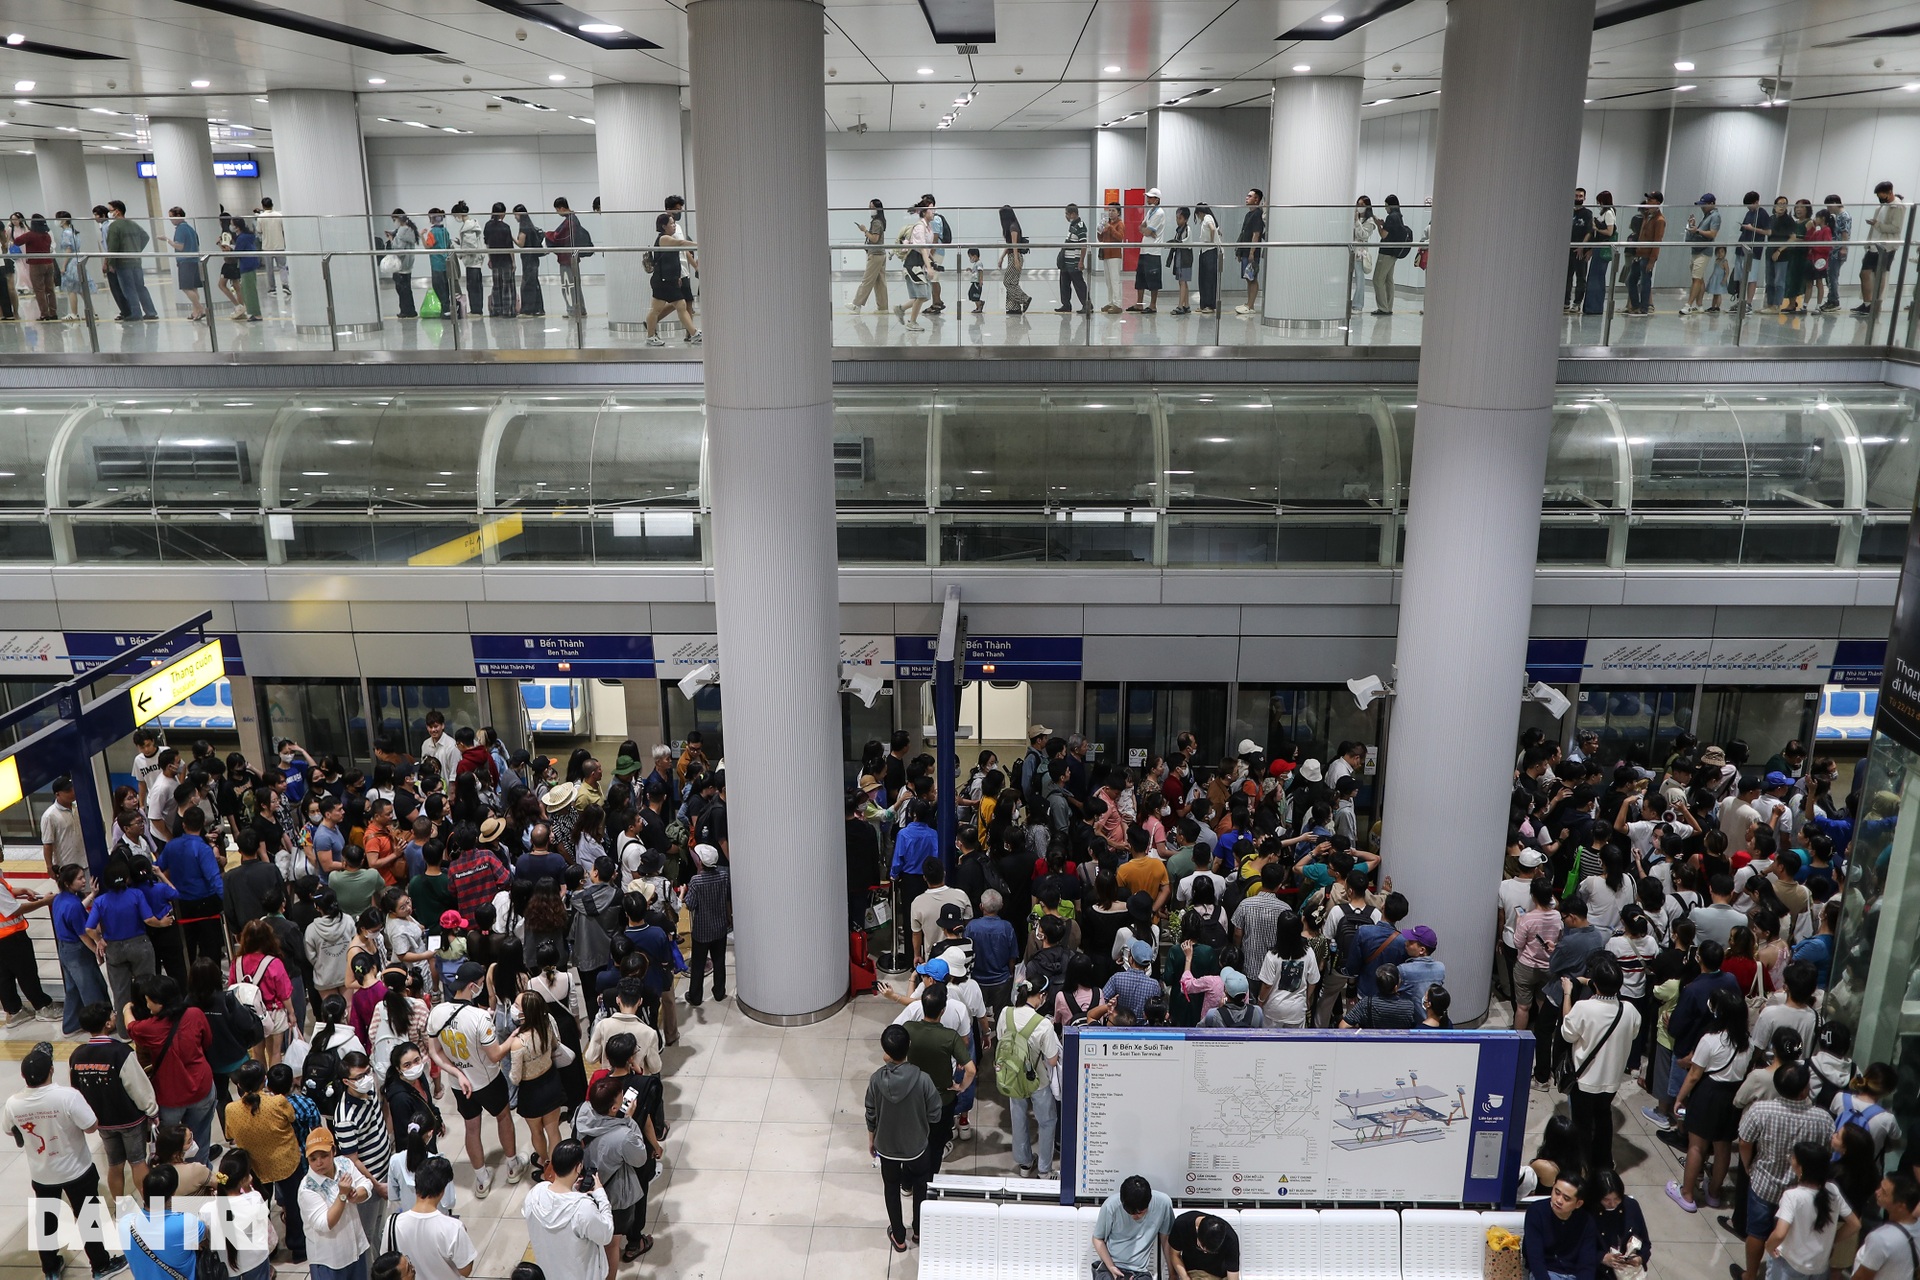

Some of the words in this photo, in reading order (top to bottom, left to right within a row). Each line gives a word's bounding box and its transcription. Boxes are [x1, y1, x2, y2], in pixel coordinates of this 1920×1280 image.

[540, 638, 556, 648] Bến
[559, 639, 584, 648] Thành
[966, 639, 982, 649] Bến
[984, 640, 1011, 649] Thành
[170, 664, 194, 683] Thang
[1102, 1044, 1107, 1056] 1
